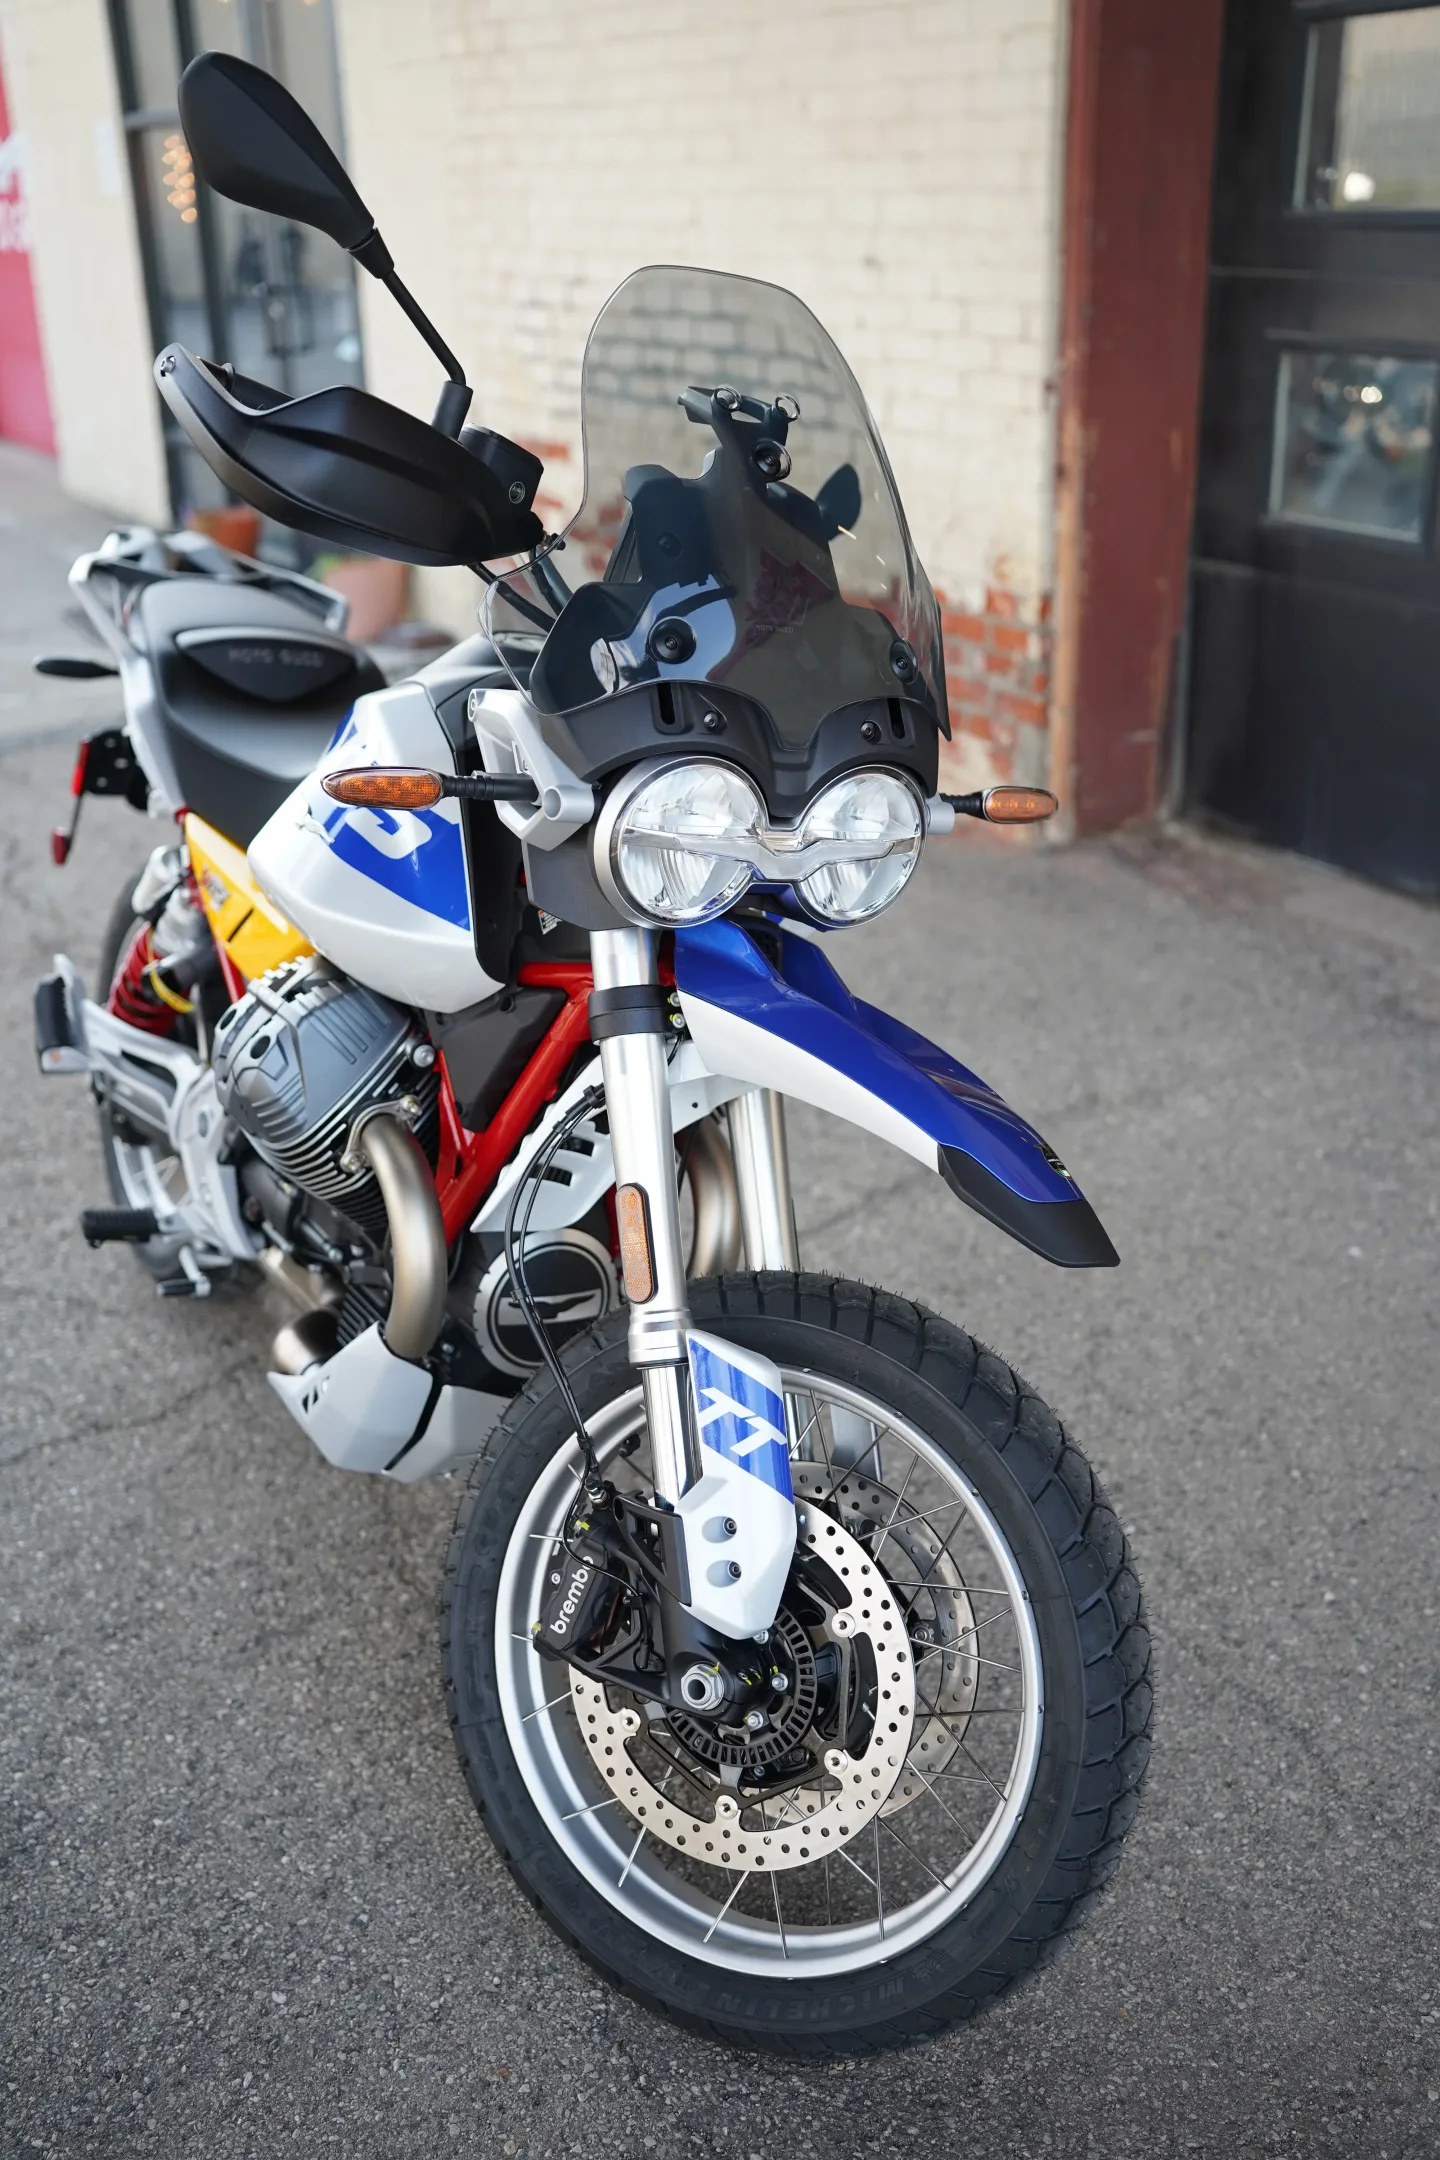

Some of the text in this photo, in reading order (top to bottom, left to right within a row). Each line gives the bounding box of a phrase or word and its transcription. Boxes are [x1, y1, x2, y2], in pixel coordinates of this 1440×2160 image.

[698, 1387, 788, 1457] TT
[550, 1554, 594, 1635] brembo
[714, 1975, 906, 2021] MICHELIN
